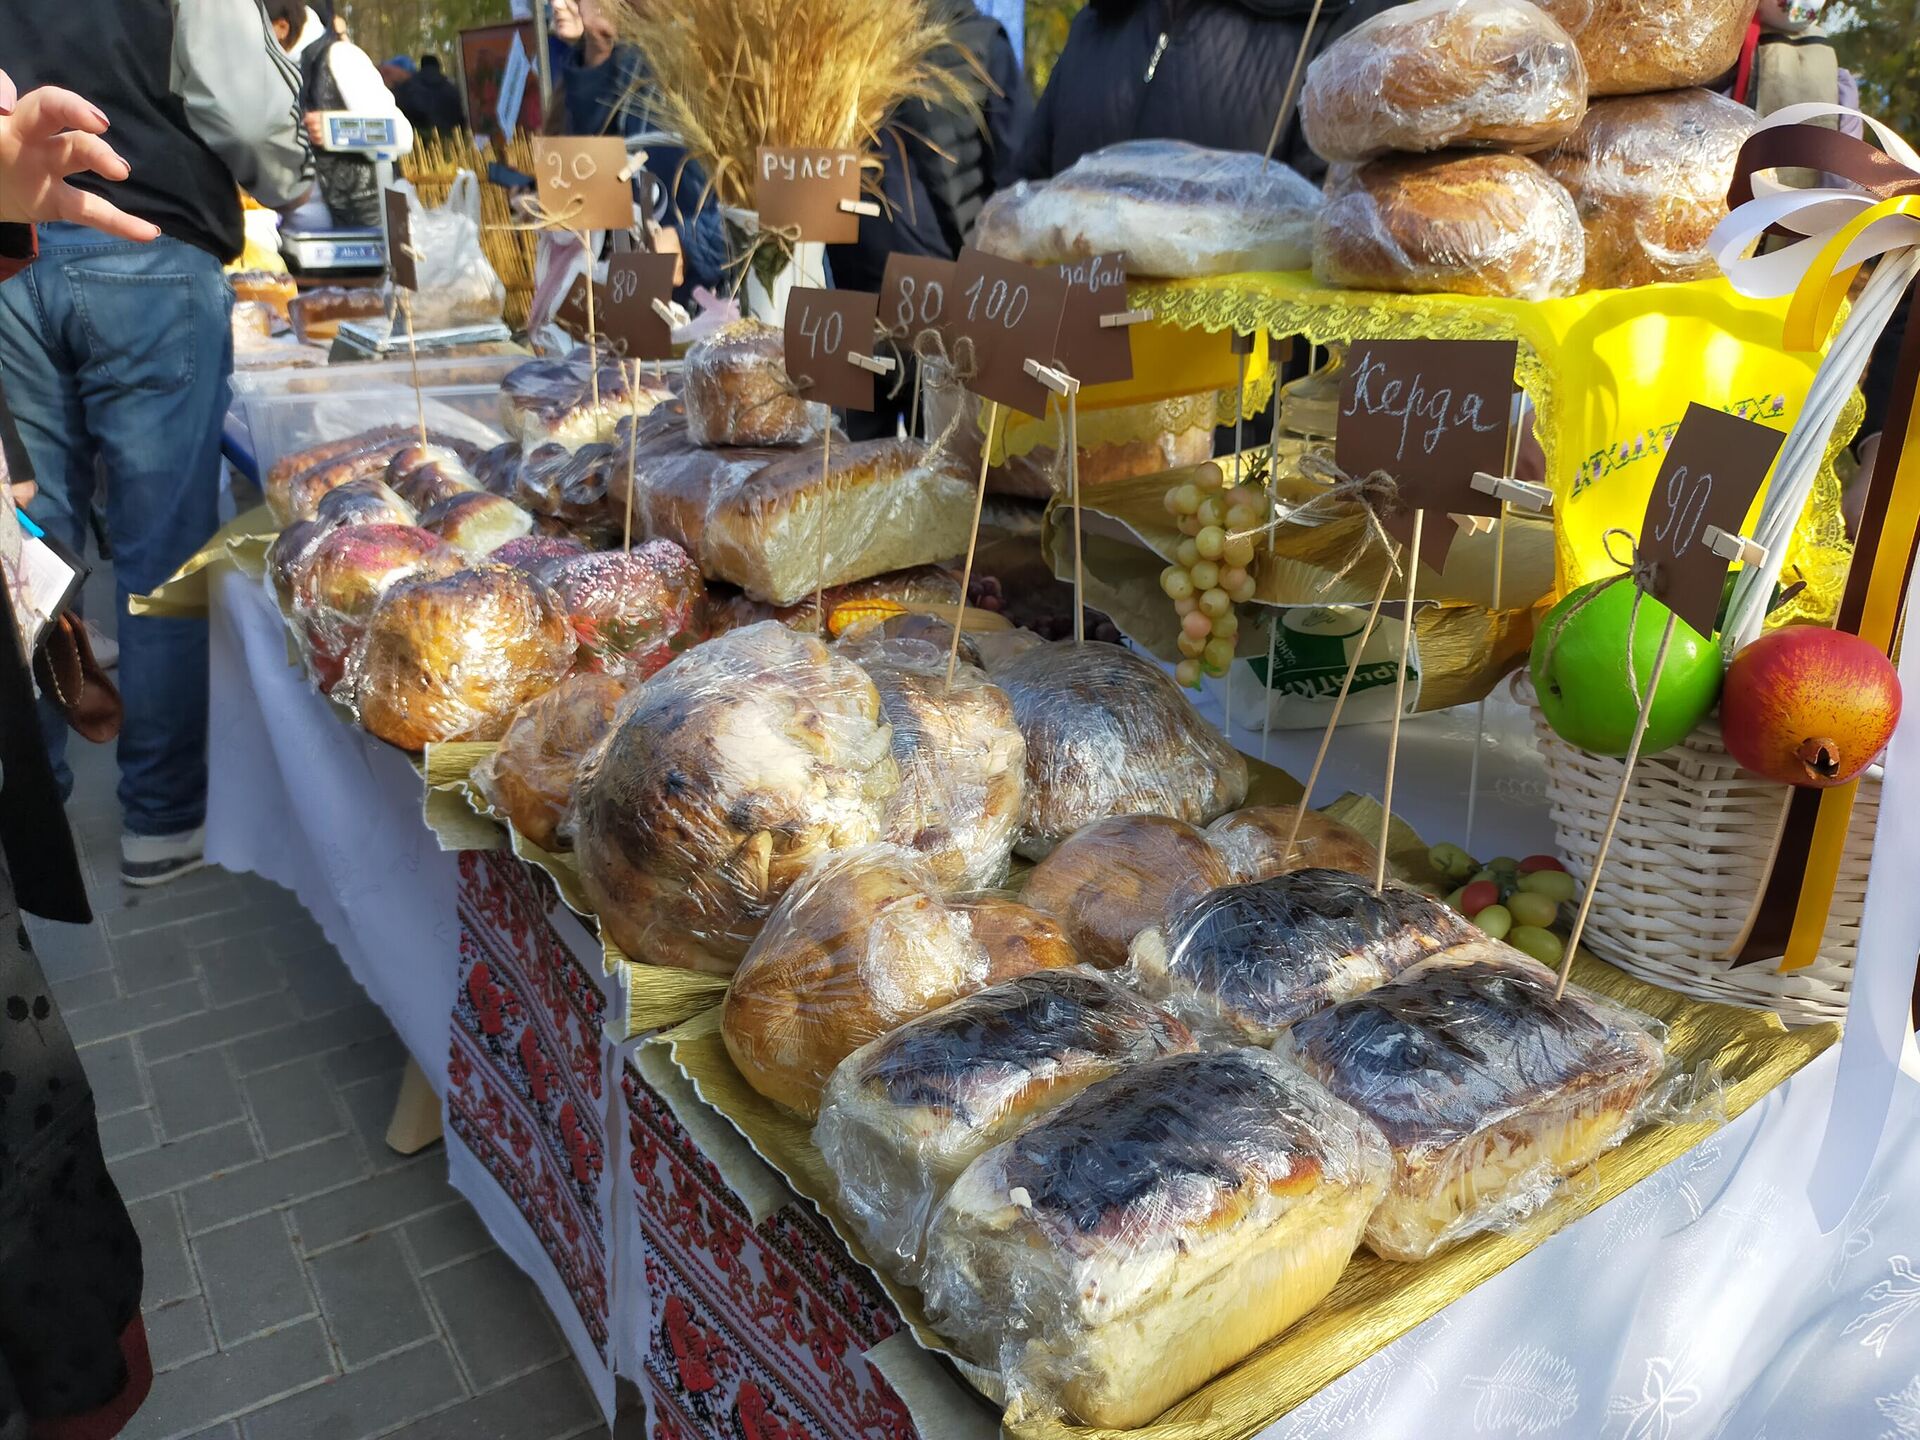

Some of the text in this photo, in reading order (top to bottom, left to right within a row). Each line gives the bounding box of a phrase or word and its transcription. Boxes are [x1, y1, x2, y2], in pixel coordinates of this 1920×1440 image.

[548, 151, 597, 189] 20
[612, 269, 638, 304] 80
[897, 275, 944, 326] 80
[964, 274, 1029, 329] 100
[801, 304, 843, 360] 40
[1654, 465, 1712, 559] 90
